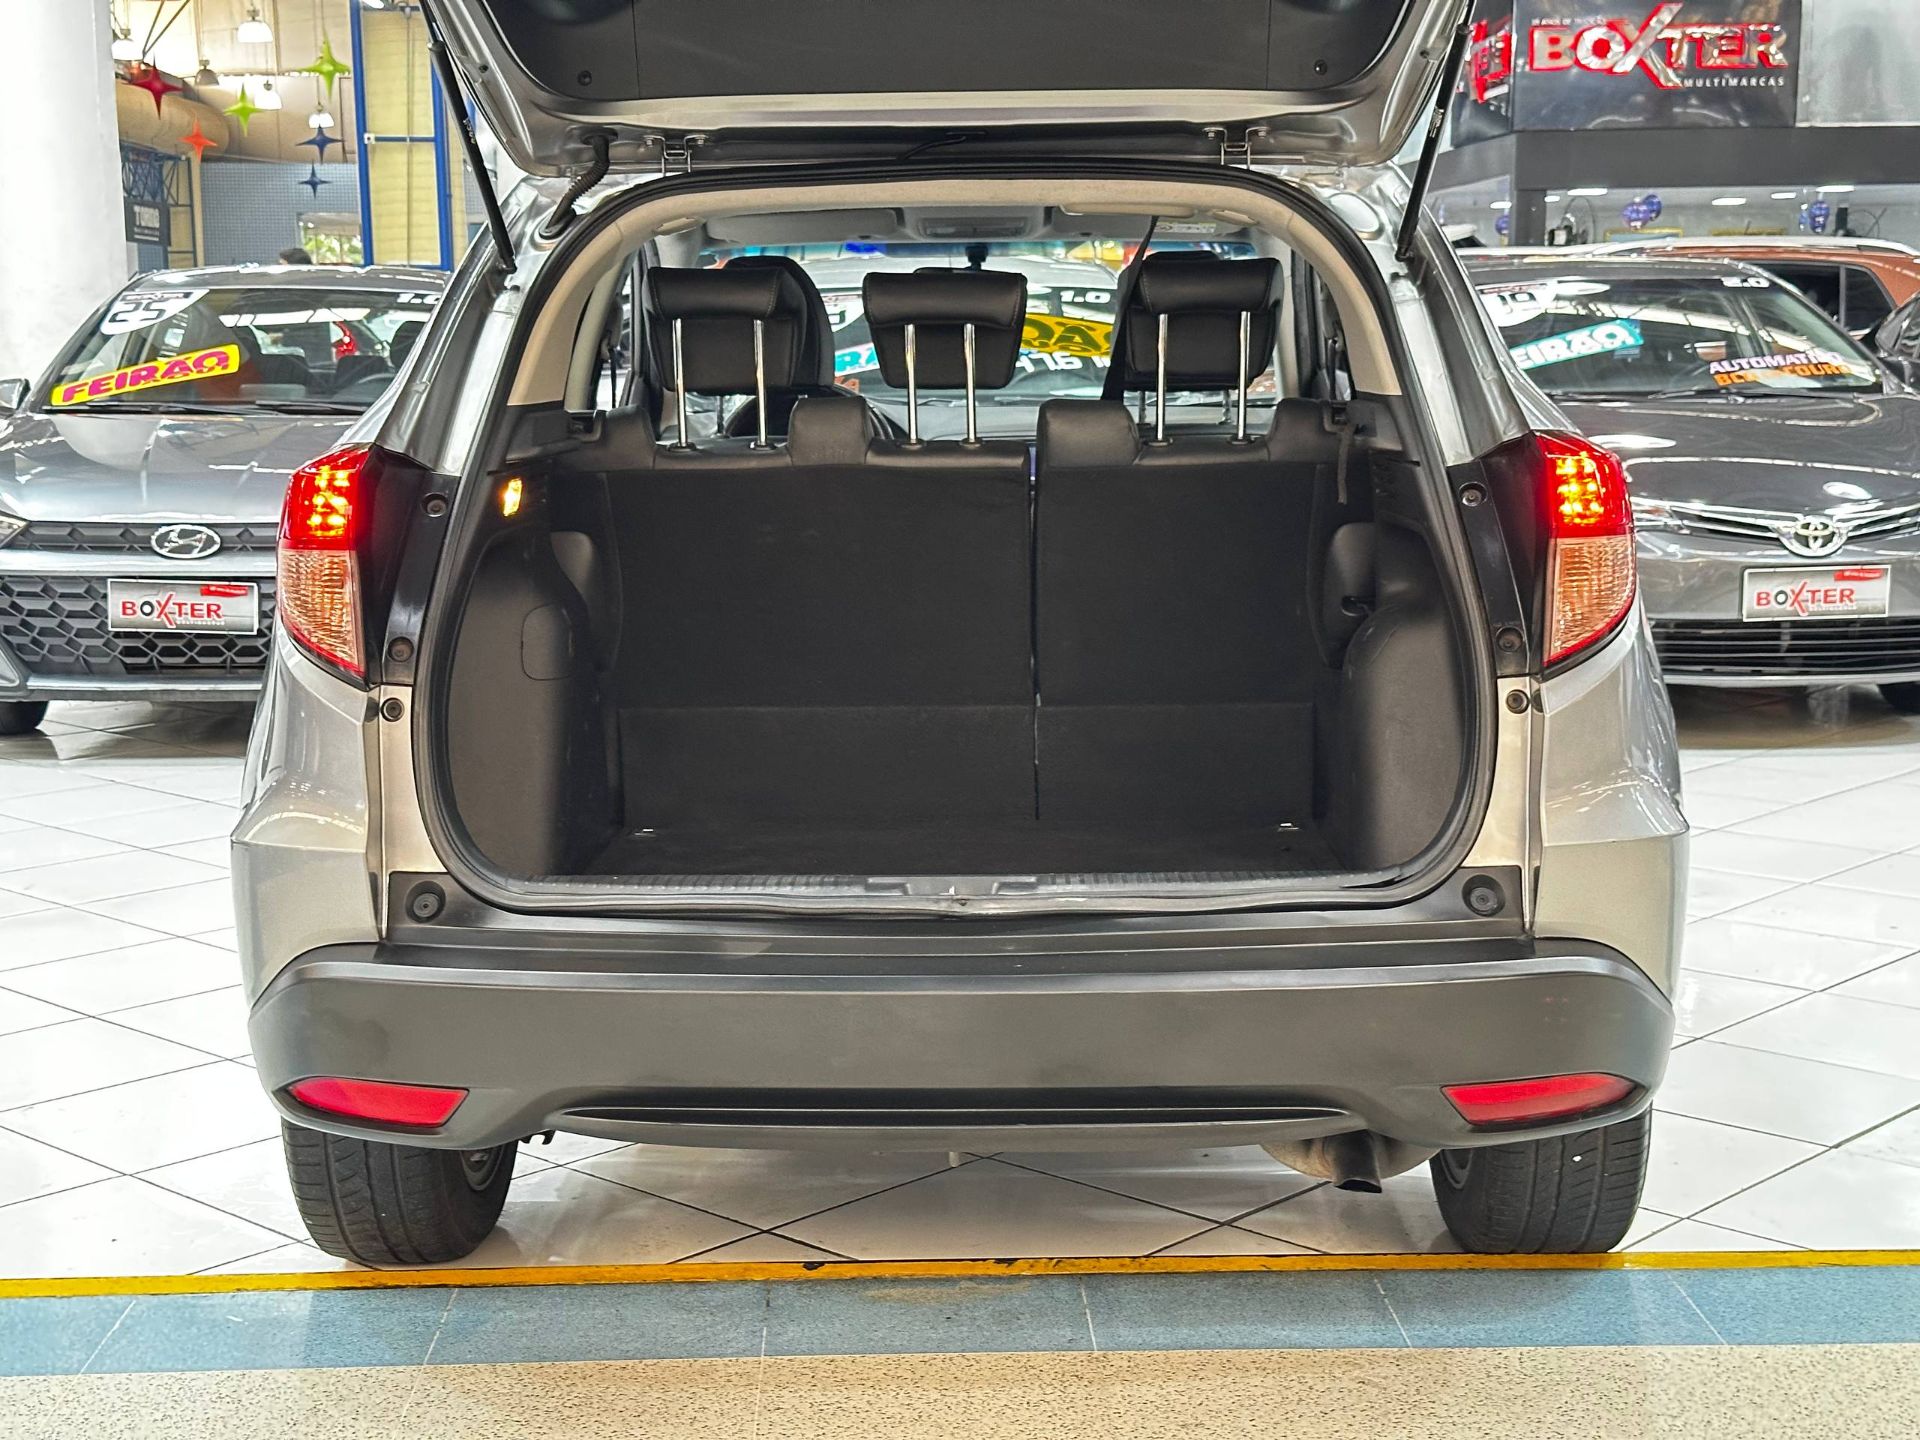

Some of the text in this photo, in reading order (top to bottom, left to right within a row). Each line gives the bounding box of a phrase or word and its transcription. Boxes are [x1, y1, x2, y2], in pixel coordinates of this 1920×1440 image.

[1528, 2, 1788, 89] BOXTER
[1683, 77, 1785, 88] MULTIMARCAS
[1721, 277, 1770, 288] 2.0
[1060, 290, 1111, 304] 1.0
[108, 300, 168, 323] 25
[1510, 324, 1635, 369] EIRÃO
[121, 593, 223, 627] BOXTER
[1755, 581, 1855, 615] BOXTER
